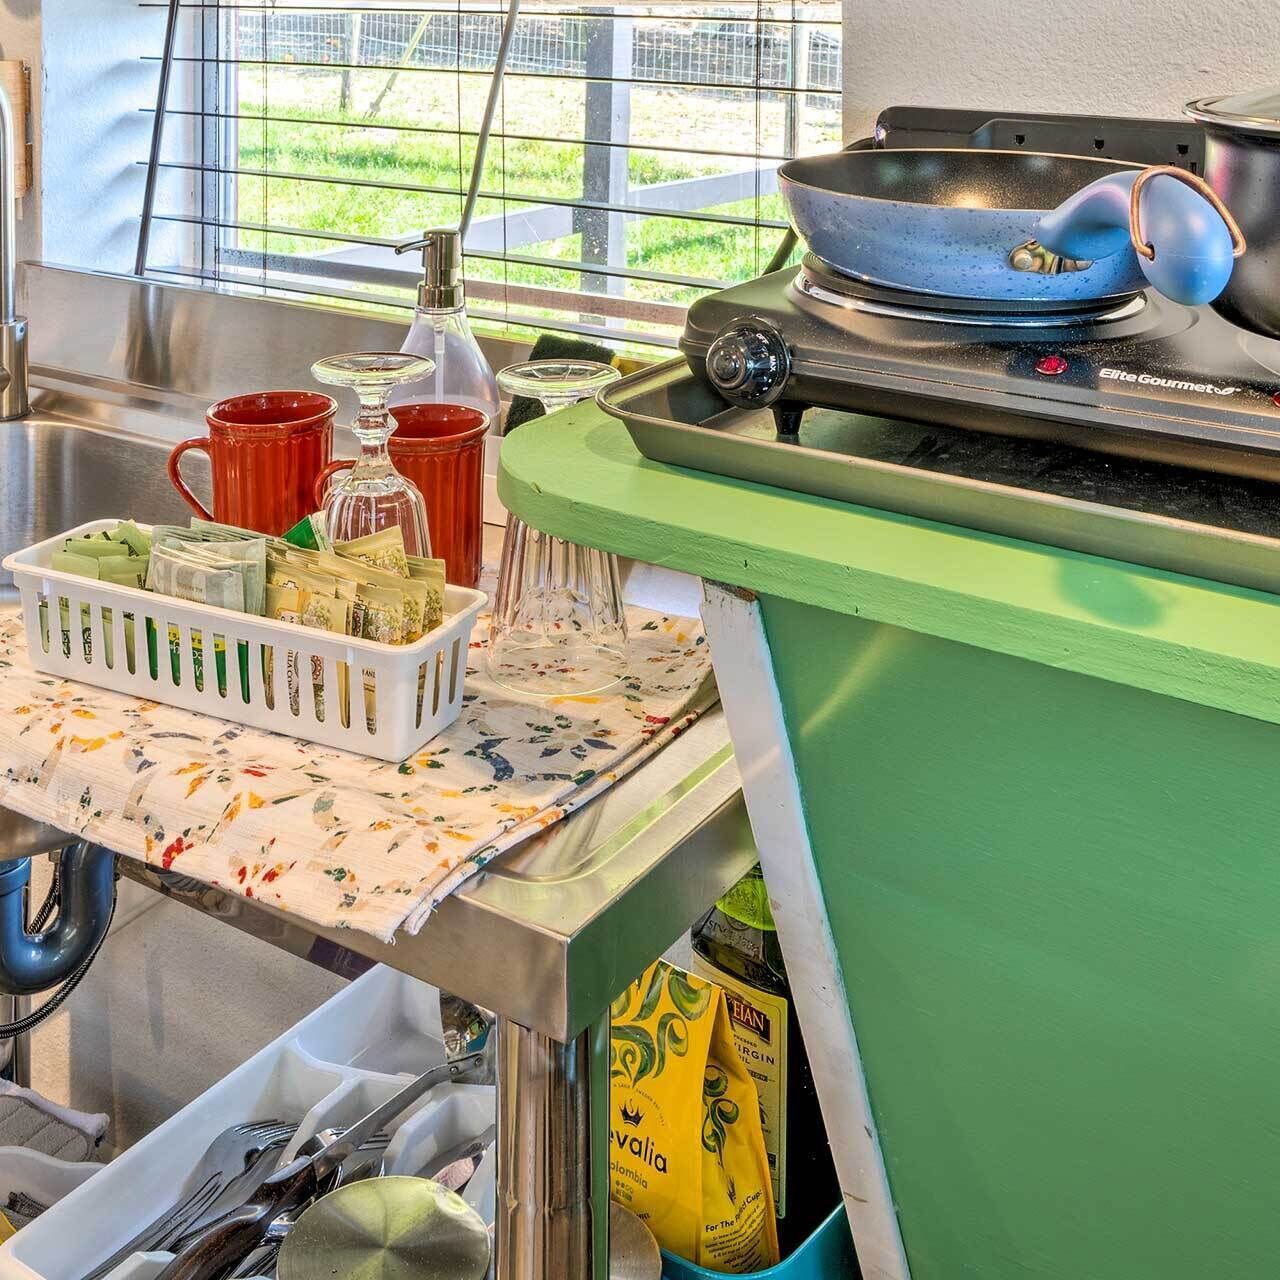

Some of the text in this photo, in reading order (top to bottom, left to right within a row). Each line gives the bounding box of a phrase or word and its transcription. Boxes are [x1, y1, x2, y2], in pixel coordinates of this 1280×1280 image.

[1099, 368, 1215, 394] Elite Gourmet
[705, 1223, 719, 1233] For
[720, 1219, 735, 1229] The
